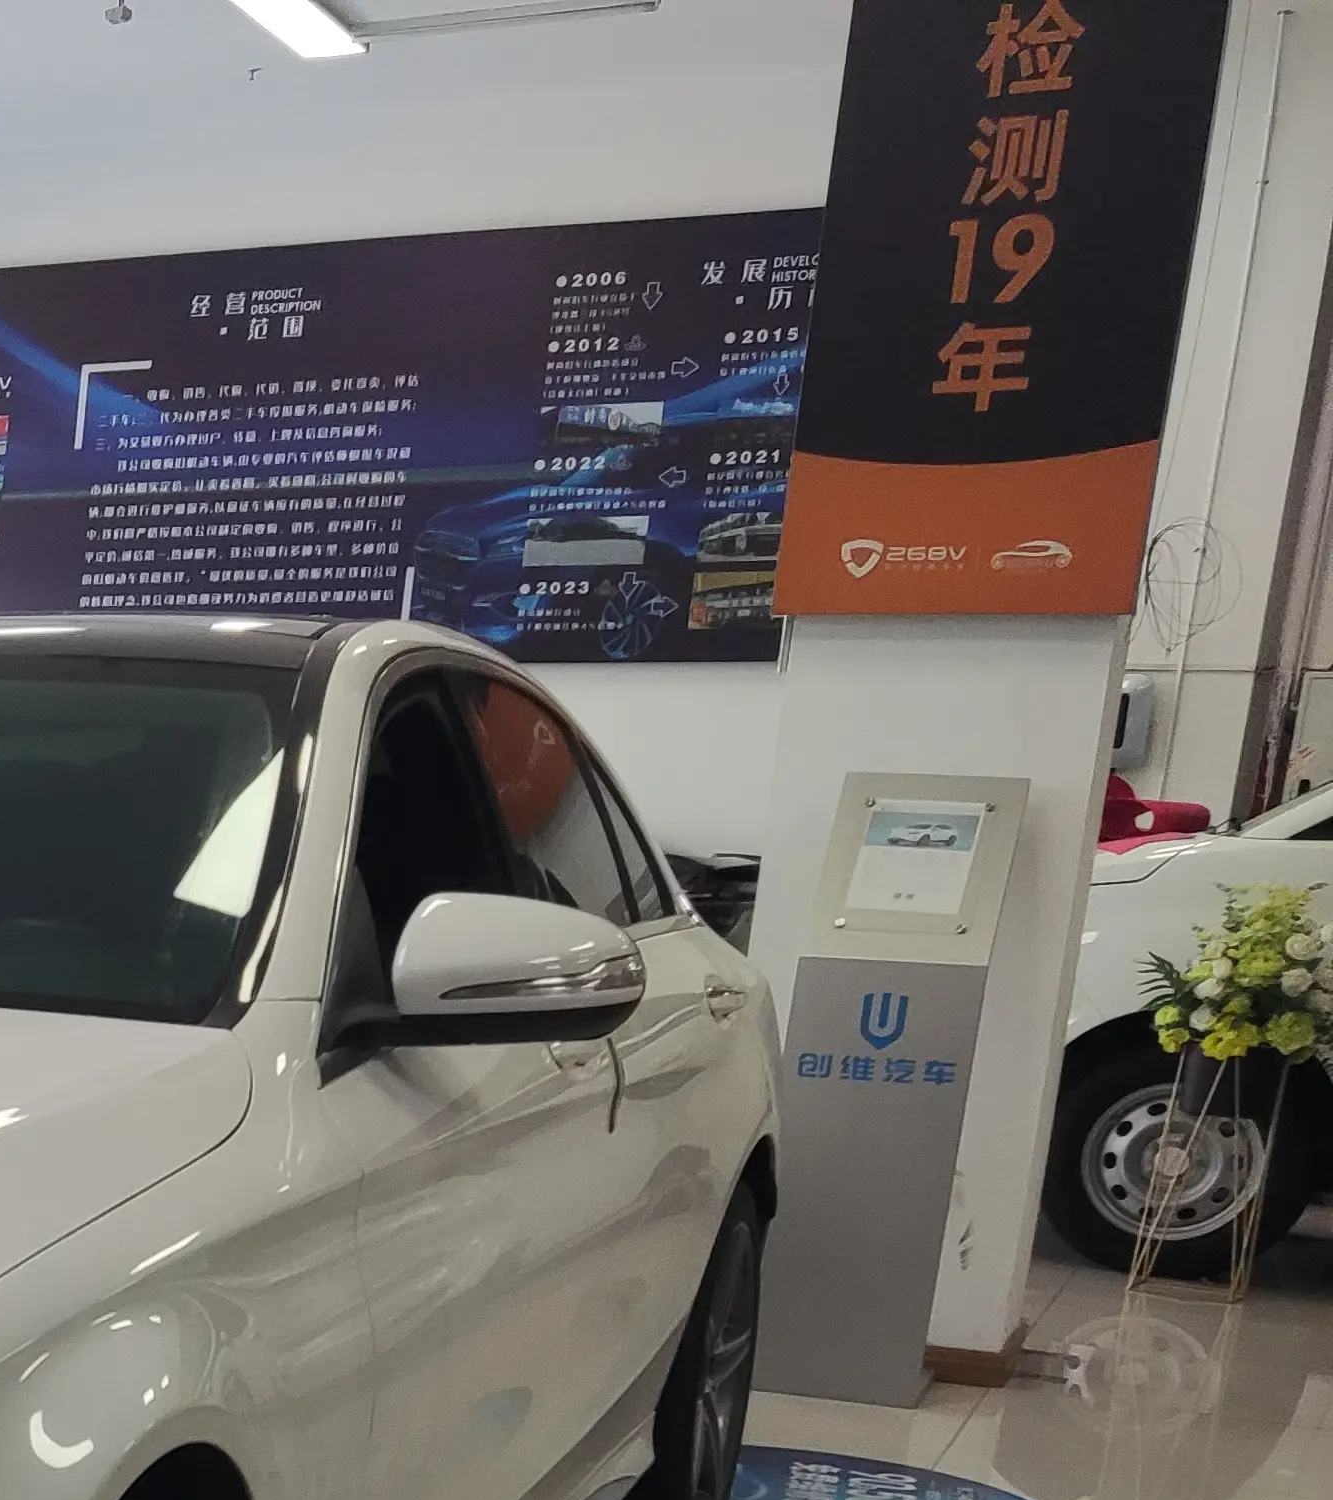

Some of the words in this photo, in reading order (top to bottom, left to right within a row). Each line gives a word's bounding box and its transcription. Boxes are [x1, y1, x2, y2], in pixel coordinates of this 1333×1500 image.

[932, 0, 1086, 413] 检测19年
[571, 271, 627, 288] 2006
[700, 258, 768, 286] 发展
[252, 286, 304, 302] PRODUCT
[767, 285, 815, 311] 历
[190, 291, 247, 317] 经营
[250, 300, 322, 315] DESCRIPTION
[247, 315, 304, 341] 范围
[740, 326, 799, 344] 2015
[563, 336, 620, 354] 2012
[550, 456, 606, 471] 2022
[725, 449, 780, 465] 2021
[535, 581, 590, 595] 2023
[797, 1053, 957, 1086] 创维汽车
